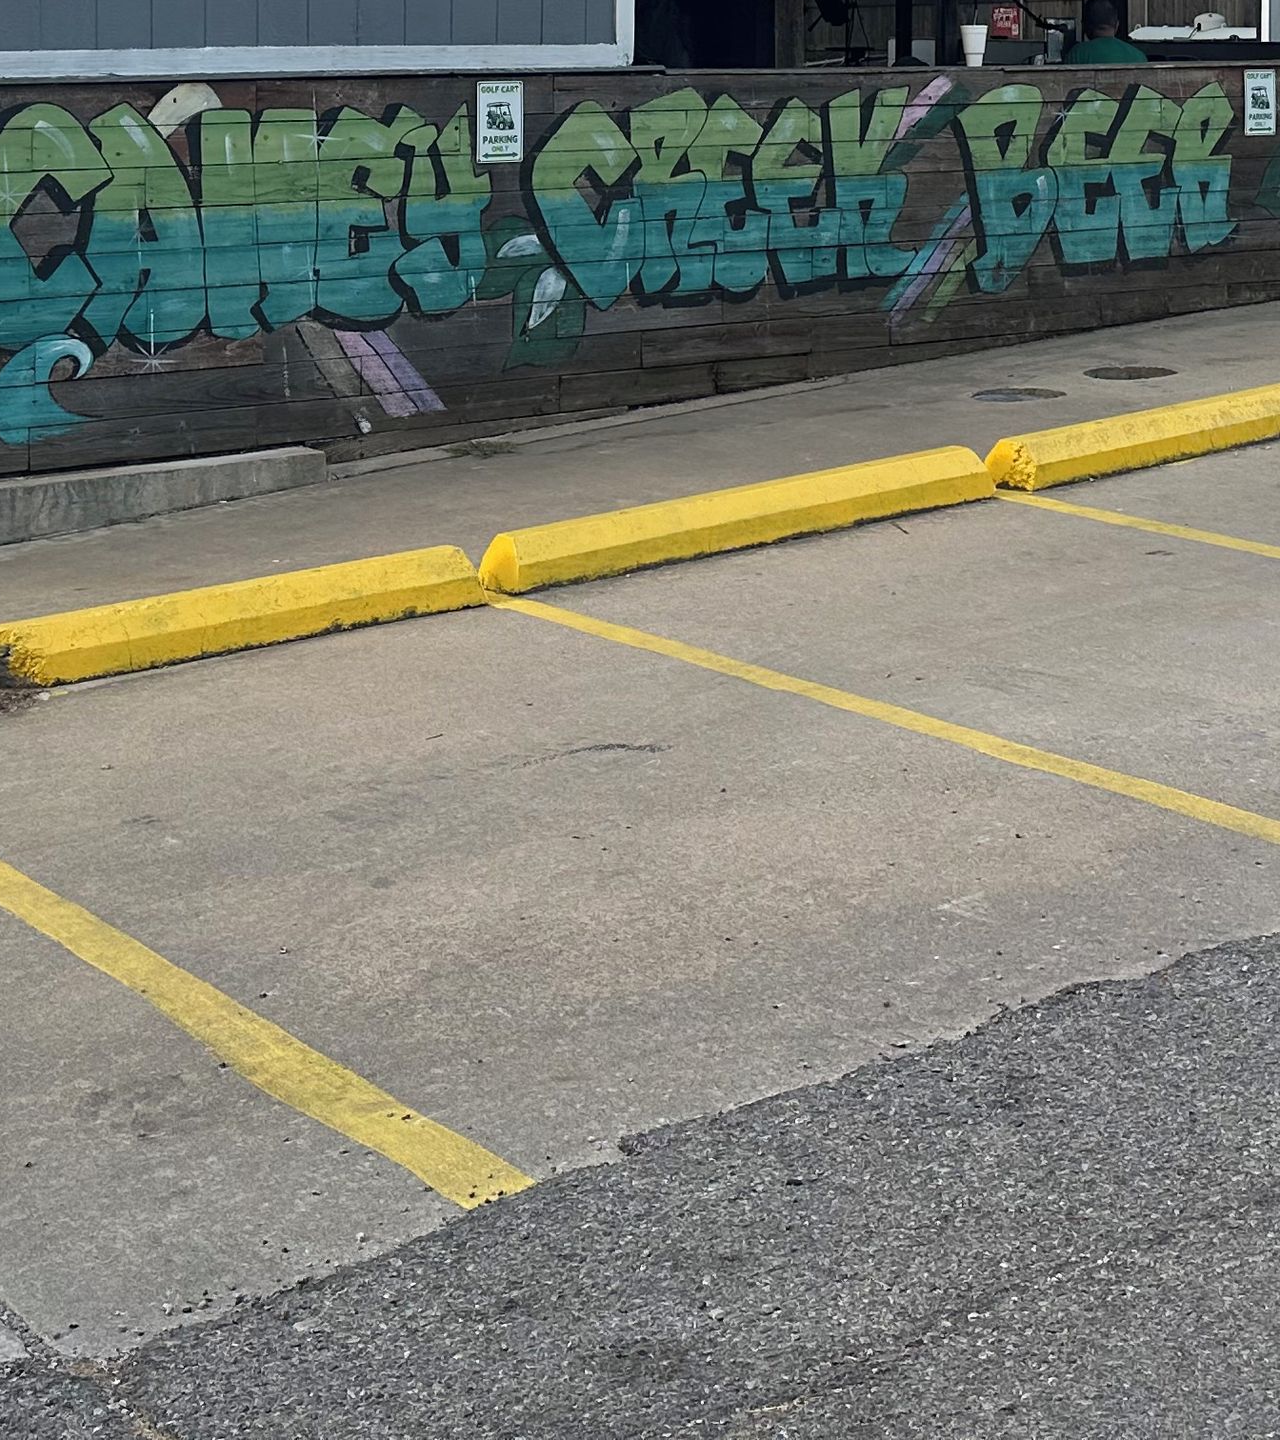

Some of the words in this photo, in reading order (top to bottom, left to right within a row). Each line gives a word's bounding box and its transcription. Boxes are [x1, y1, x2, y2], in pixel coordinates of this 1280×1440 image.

[480, 85, 500, 94] GOLF
[500, 85, 519, 93] CART
[482, 135, 518, 144] PARKING
